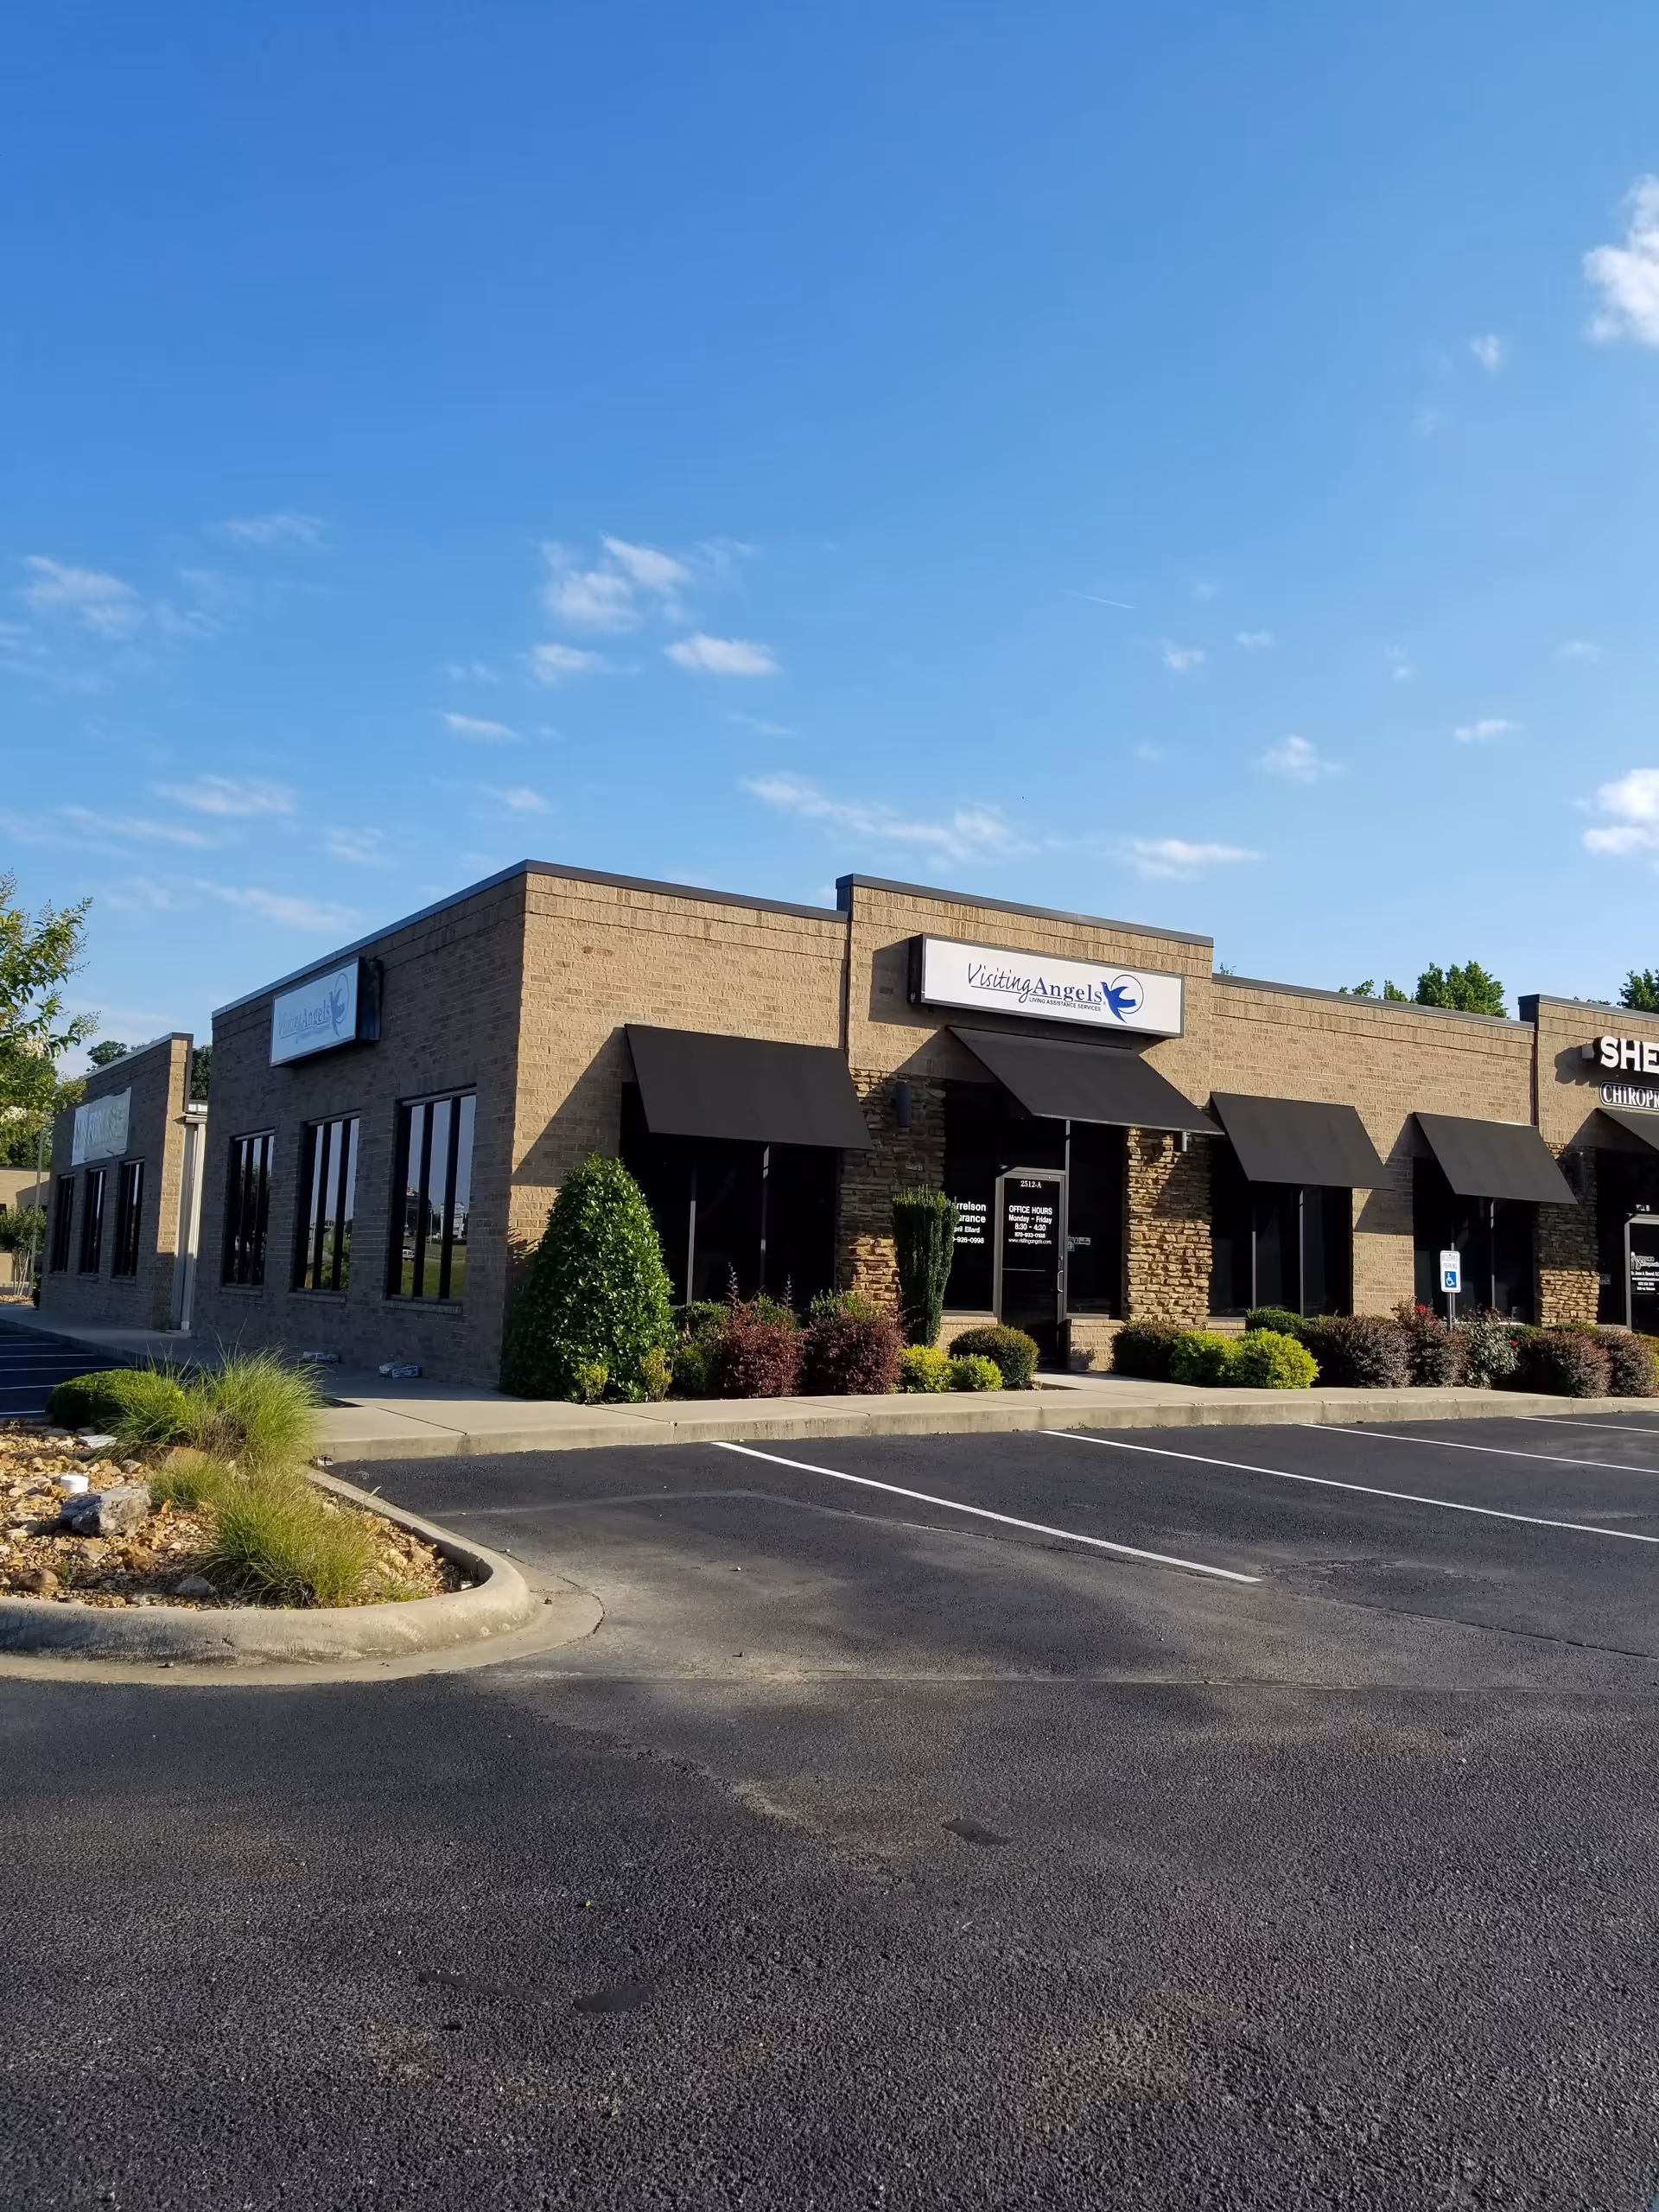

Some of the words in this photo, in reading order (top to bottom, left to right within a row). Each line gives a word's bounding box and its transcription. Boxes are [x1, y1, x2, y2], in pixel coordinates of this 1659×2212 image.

[968, 962, 1033, 1003] Visiting
[1033, 976, 1103, 1003] Angels
[1029, 996, 1046, 1005] LIVING
[1046, 999, 1077, 1009] ASSISTANCE
[1077, 1003, 1102, 1012] SERVICES
[1020, 1179, 1041, 1188] 2512-A
[954, 1201, 986, 1211] rrelson
[1008, 1205, 1031, 1214] OFFICE
[1032, 1206, 1052, 1215] HOURS
[1008, 1214, 1030, 1224] Monday
[1036, 1216, 1052, 1225] Friday
